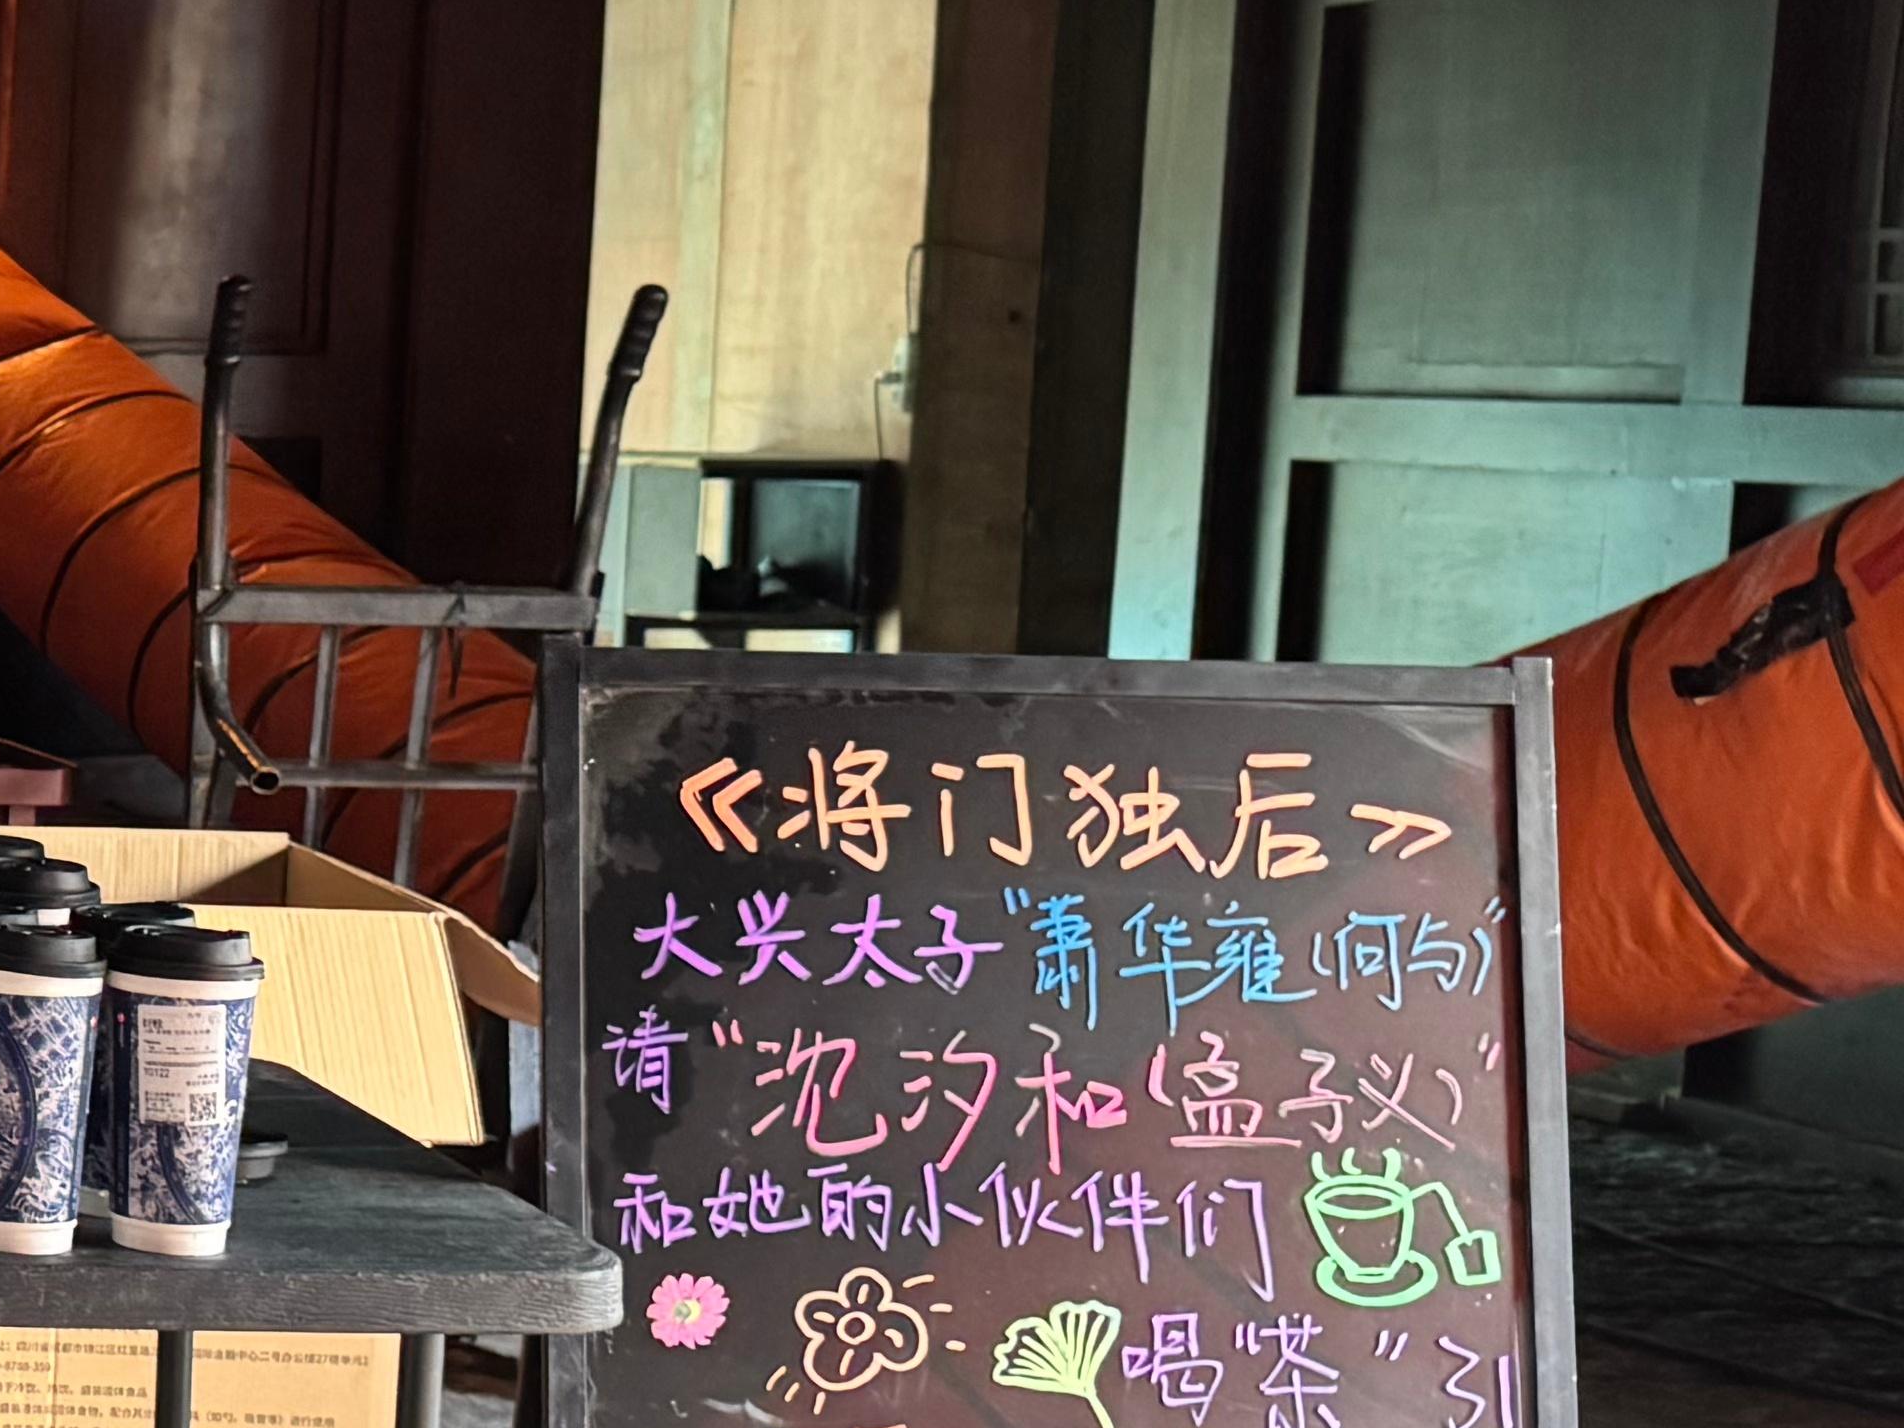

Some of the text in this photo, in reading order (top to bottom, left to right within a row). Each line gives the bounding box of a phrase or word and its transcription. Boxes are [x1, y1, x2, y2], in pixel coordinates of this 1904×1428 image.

[679, 739, 1453, 880] 《将门独后》
[613, 1163, 1276, 1301] 和她的小伙伴们
